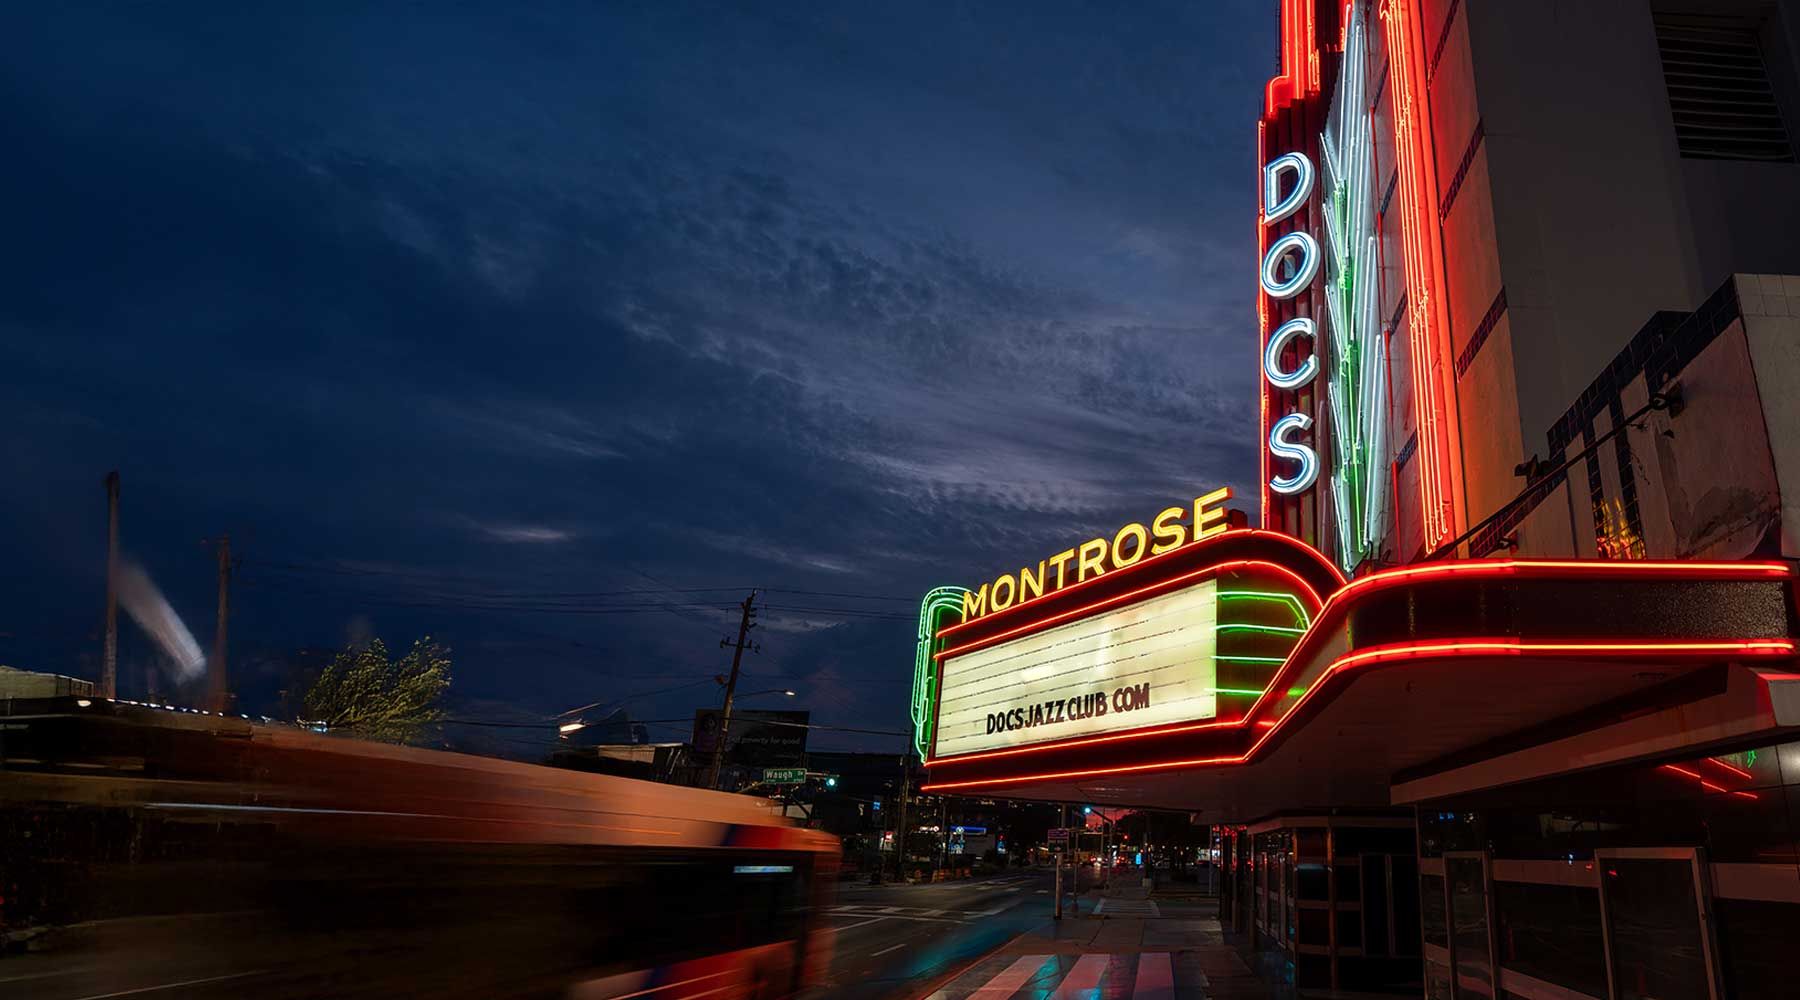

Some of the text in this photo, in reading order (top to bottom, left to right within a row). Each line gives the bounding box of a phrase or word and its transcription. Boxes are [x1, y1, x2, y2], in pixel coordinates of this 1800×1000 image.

[1261, 150, 1321, 496] DOCS
[961, 486, 1232, 624] MONTROSE
[1112, 682, 1150, 714] COM
[766, 771, 793, 781] Waugh
